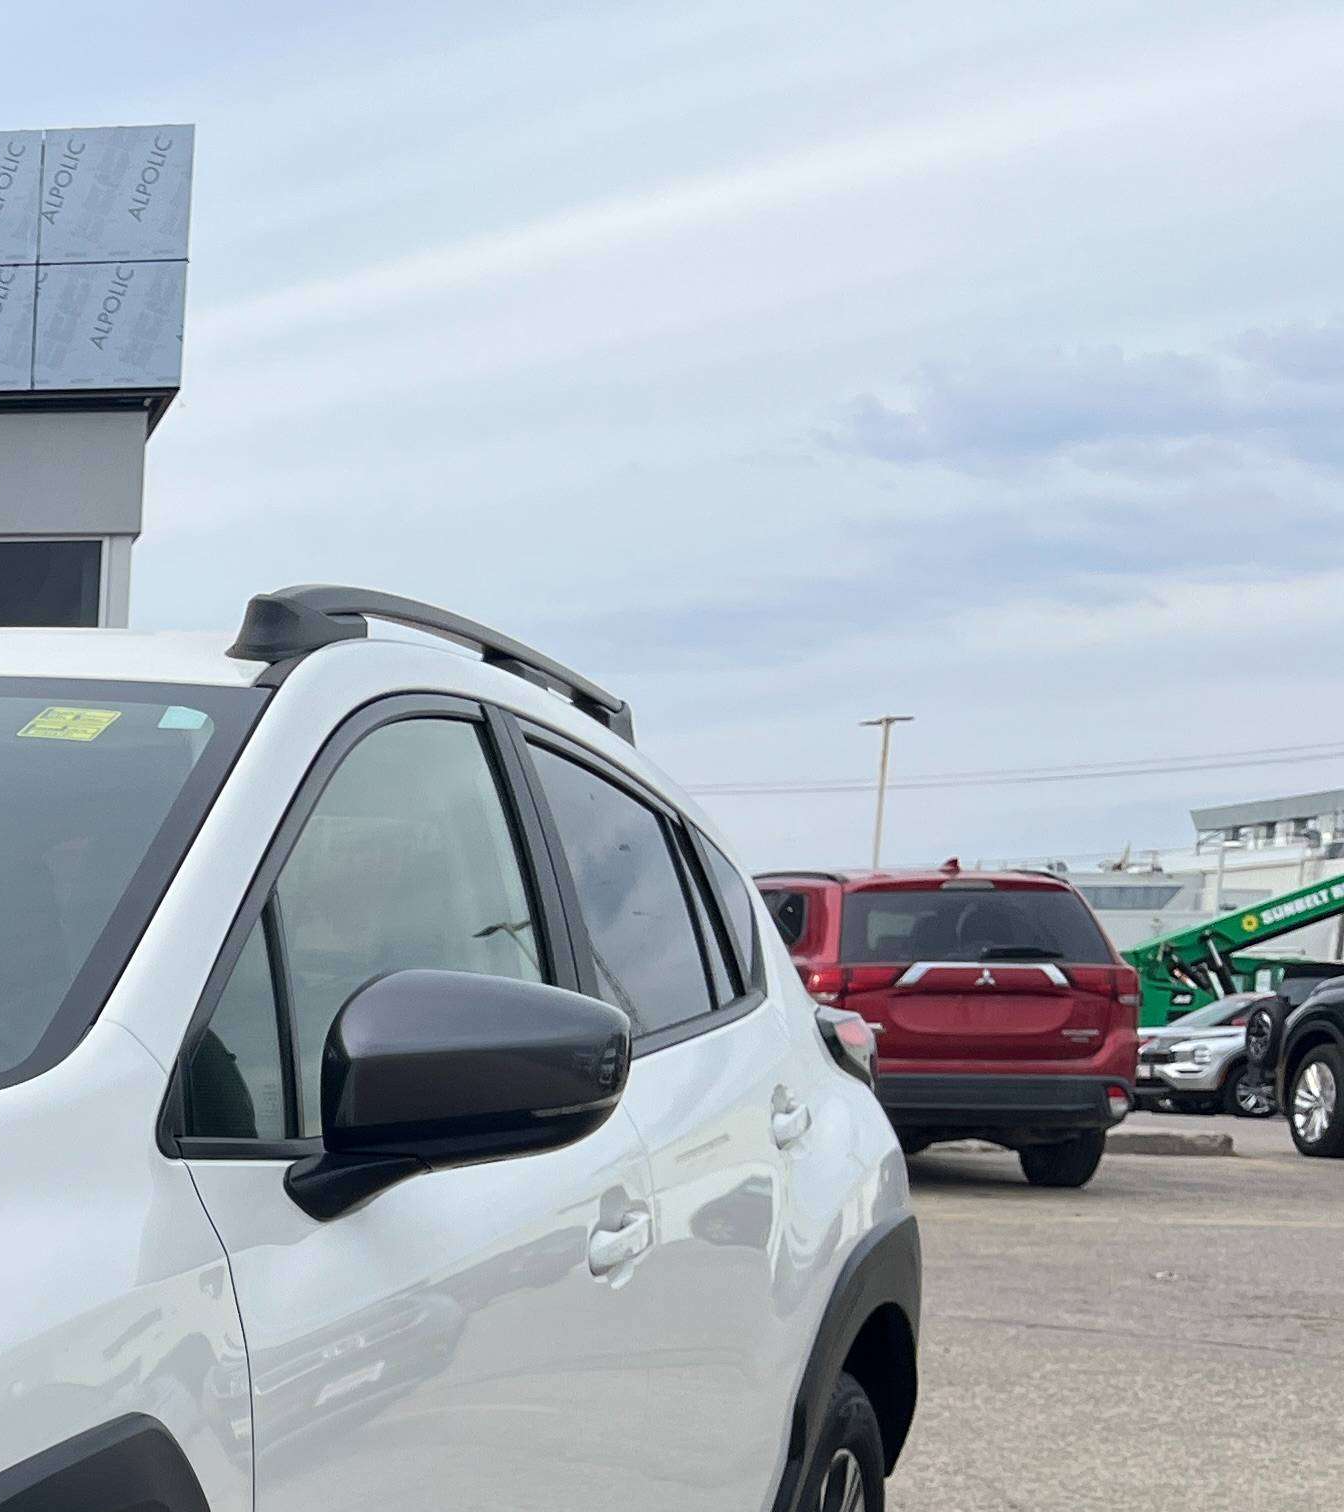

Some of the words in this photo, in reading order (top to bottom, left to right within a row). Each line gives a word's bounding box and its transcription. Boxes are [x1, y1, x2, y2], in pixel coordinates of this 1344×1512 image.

[40, 138, 87, 226] ALPOLIC
[128, 135, 173, 223] ALPOLIC
[89, 266, 135, 351] ALPOLIC
